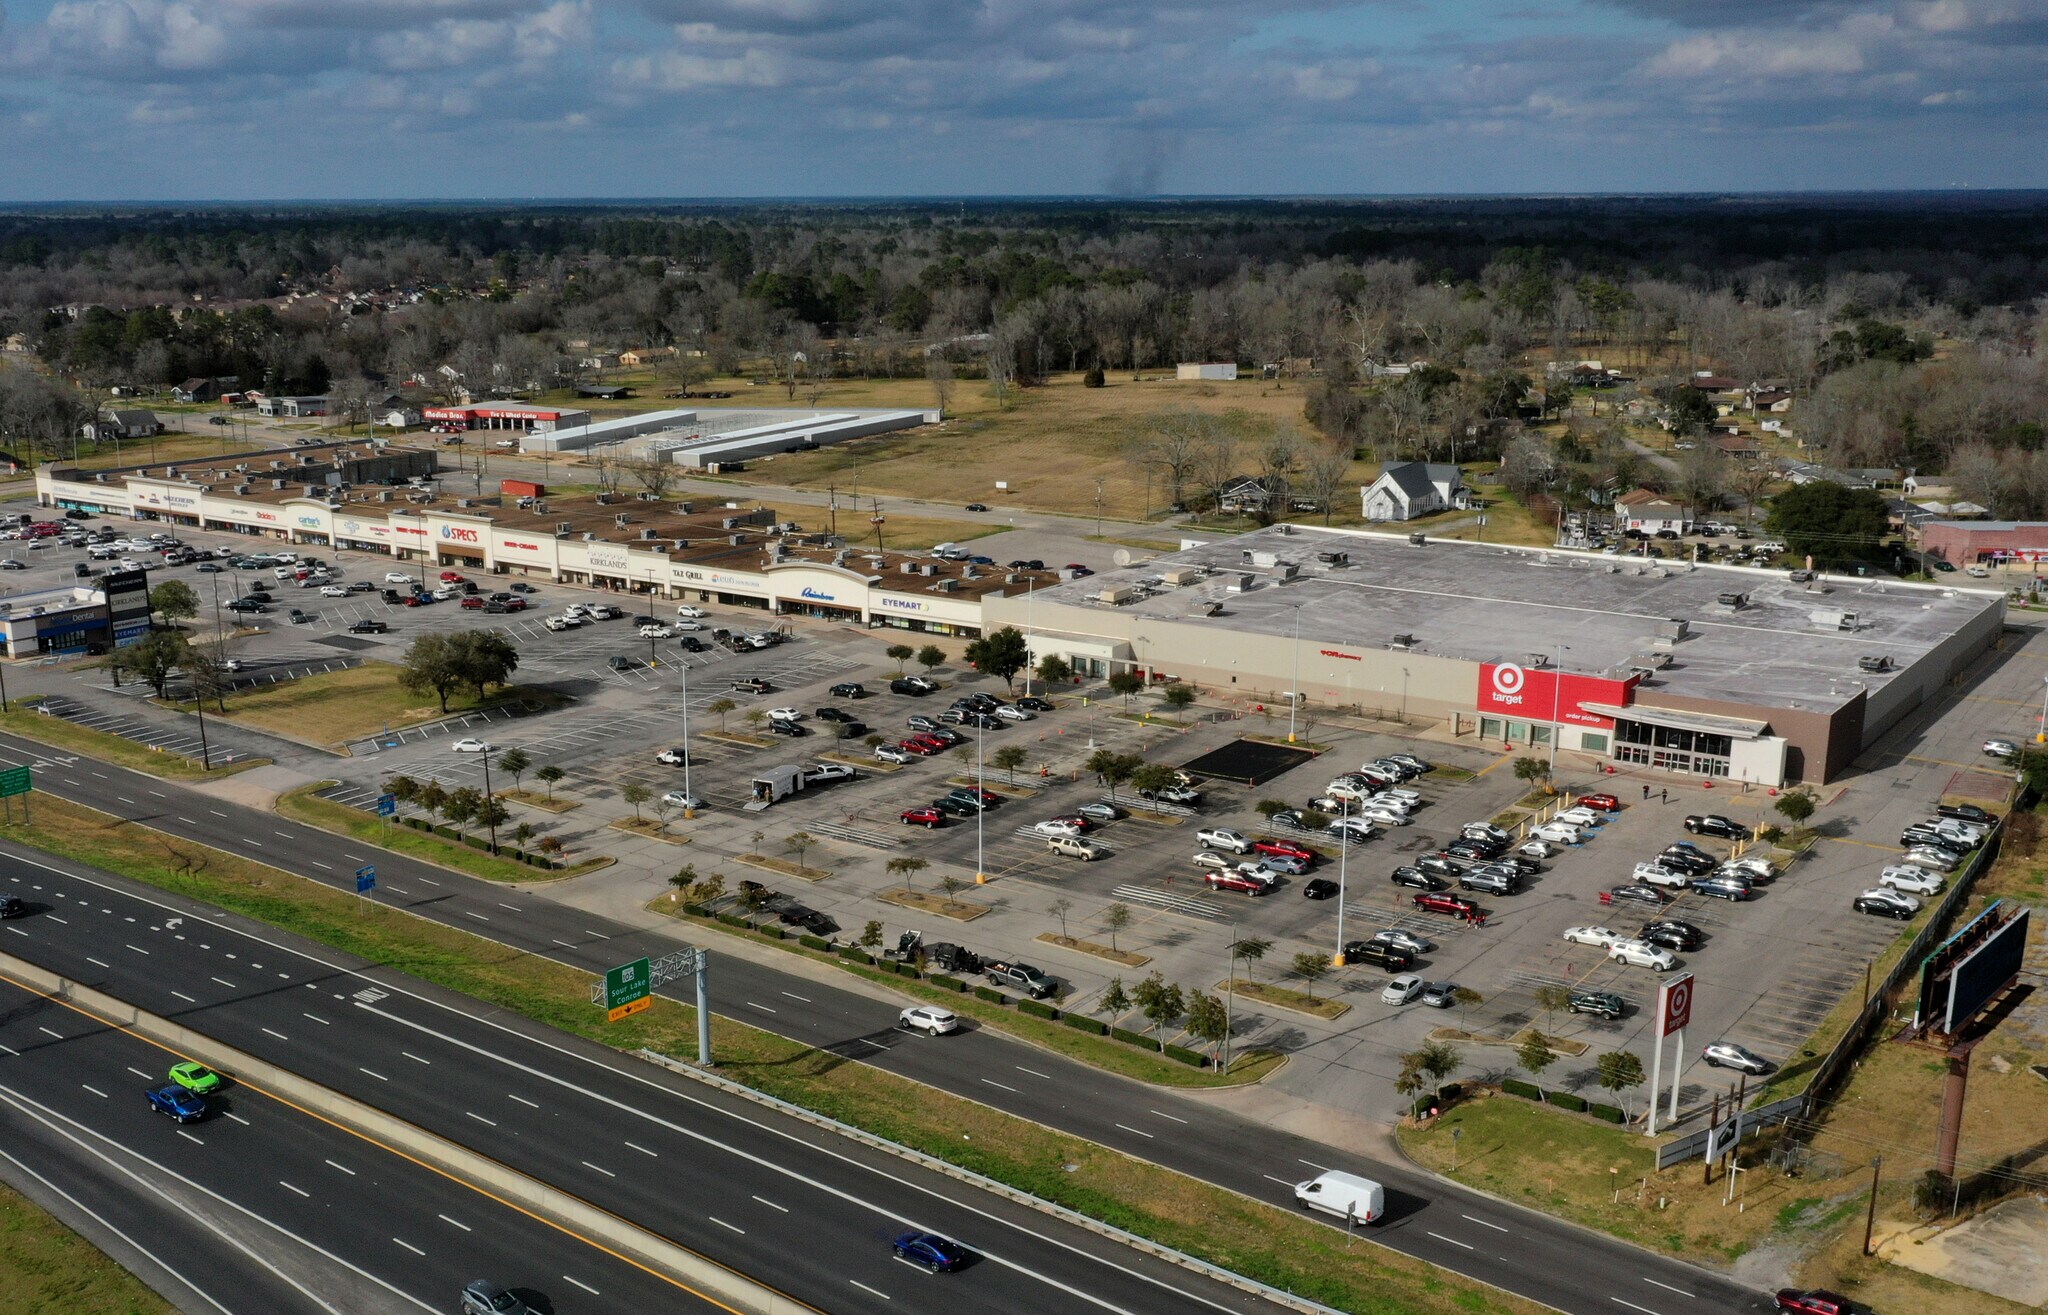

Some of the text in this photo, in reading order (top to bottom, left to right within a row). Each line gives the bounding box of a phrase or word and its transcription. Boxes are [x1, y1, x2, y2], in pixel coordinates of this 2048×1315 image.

[685, 570, 703, 580] GRILL
[801, 587, 834, 600] Rainbow
[882, 598, 921, 610] EYEMART
[73, 612, 95, 621] Dental
[1492, 692, 1522, 704] target
[612, 980, 646, 997] Sour Lake
[616, 991, 641, 1004] Conroe
[1668, 1012, 1686, 1028] target
